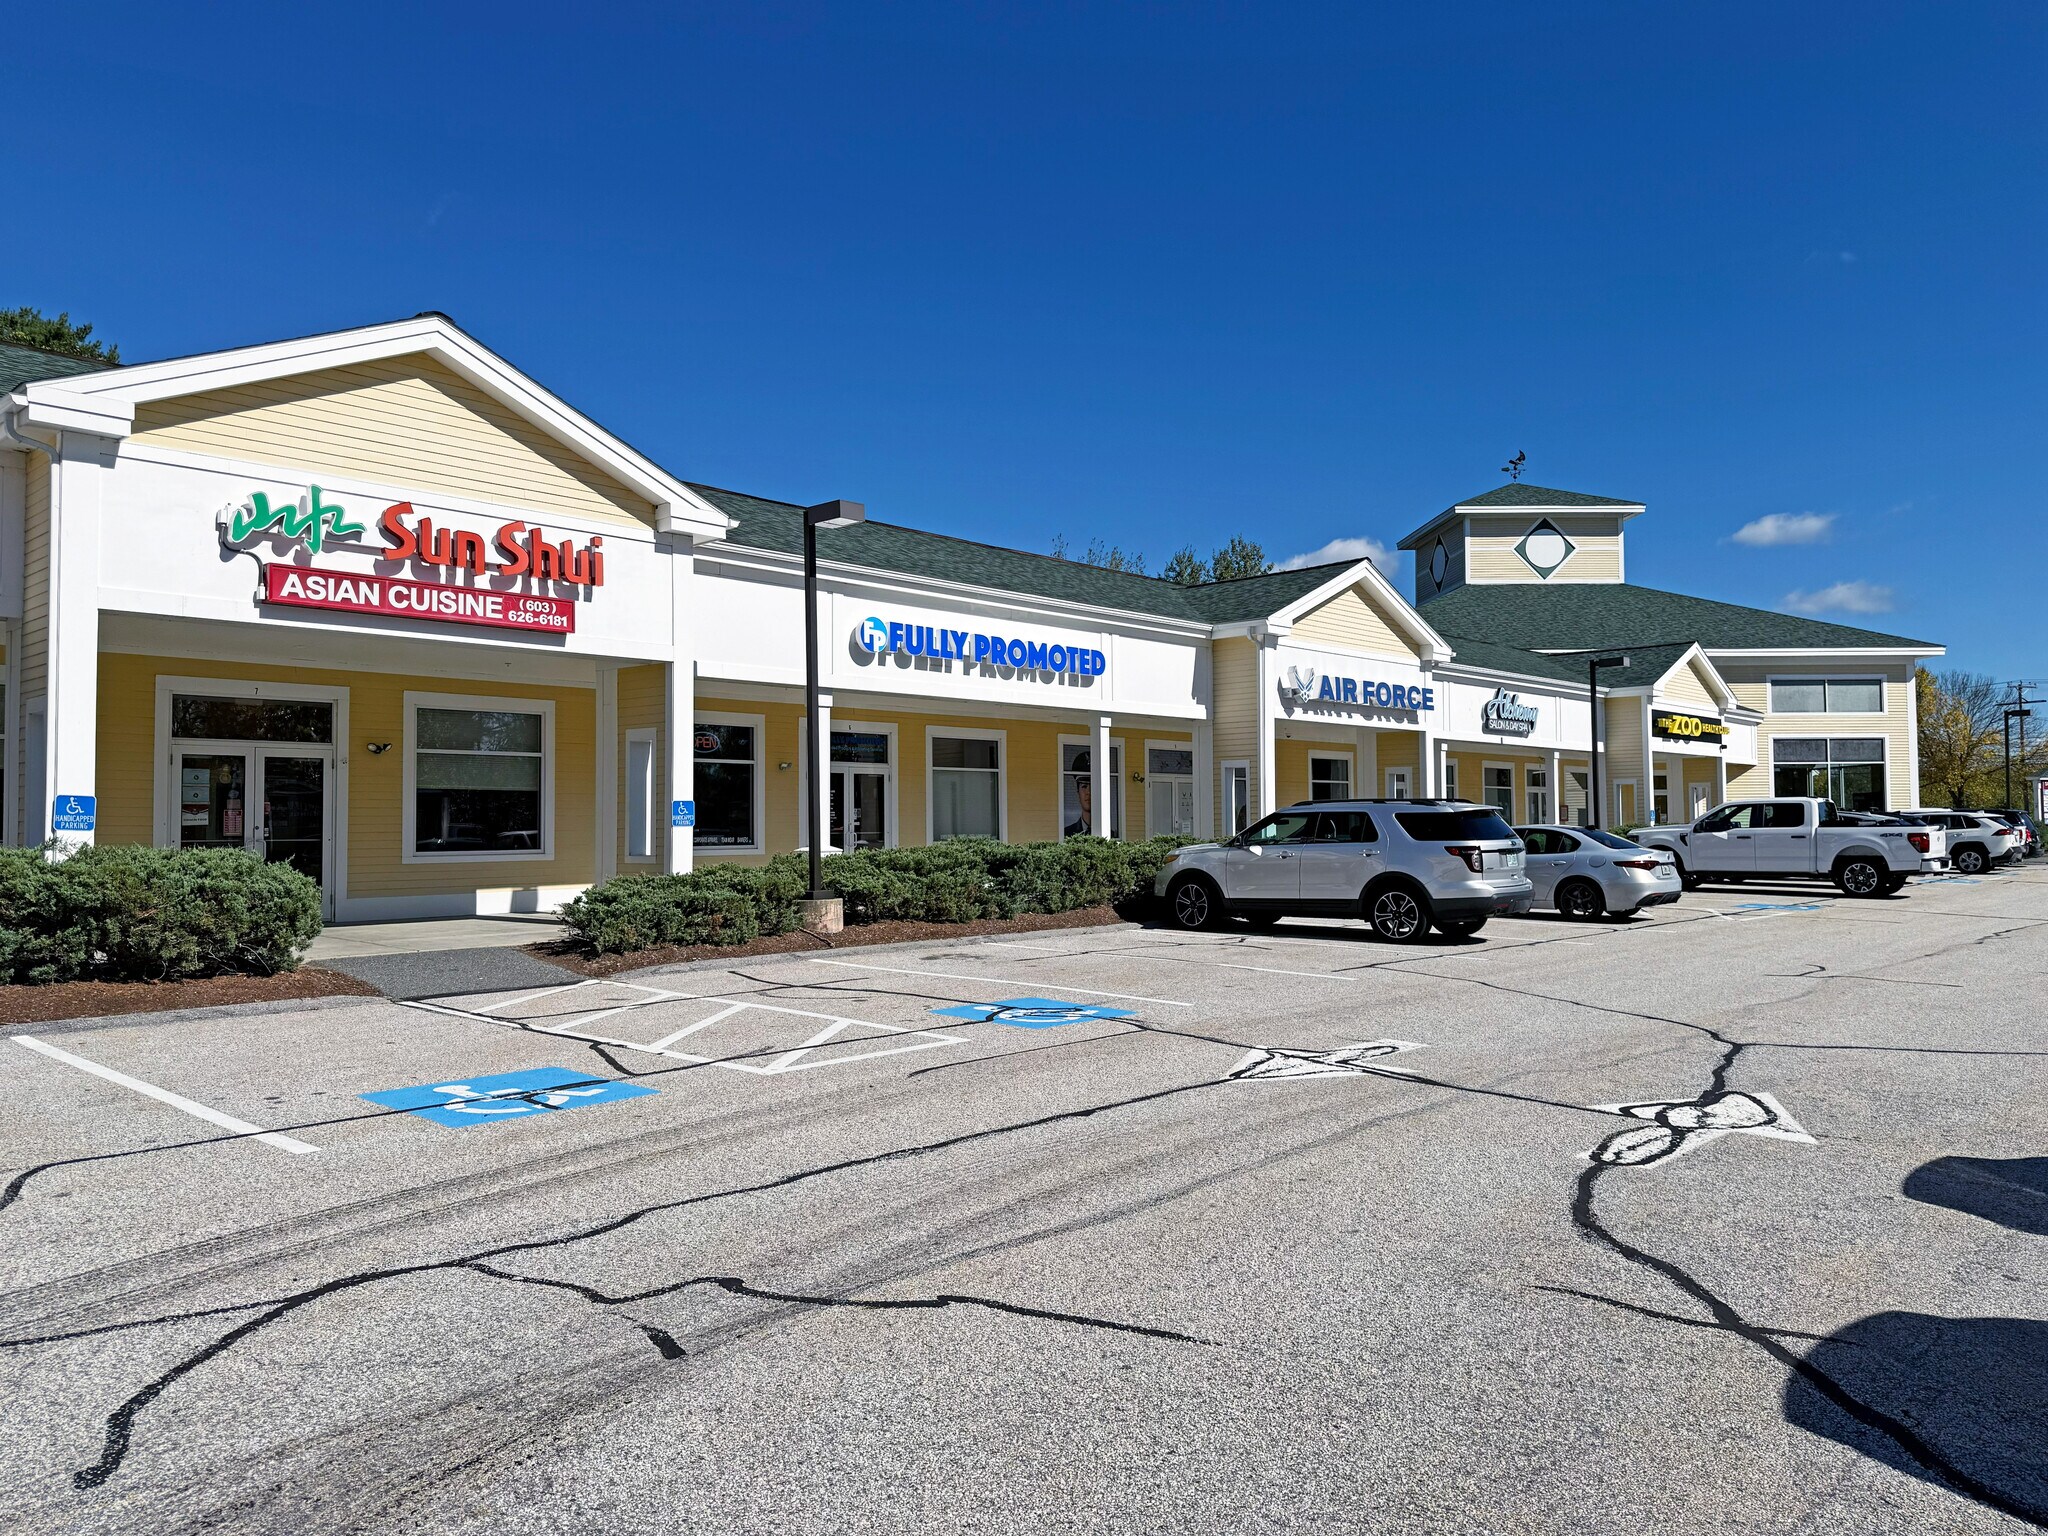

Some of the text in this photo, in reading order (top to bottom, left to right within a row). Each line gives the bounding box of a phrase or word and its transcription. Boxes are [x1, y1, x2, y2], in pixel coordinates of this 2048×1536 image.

[381, 501, 604, 587] Sun Shui
[280, 571, 504, 619] ASIAN CUISINE
[519, 598, 557, 615] (603)
[508, 609, 568, 627] 626-6181
[889, 621, 1106, 677] FULLY PROMOTED
[1319, 674, 1435, 711] AIR FORCE
[1489, 719, 1505, 730] SALON
[1669, 715, 1702, 737] ZOO
[695, 736, 717, 748] PEN
[55, 814, 94, 823] HANDICAPPED
[60, 821, 89, 829] PARKING
